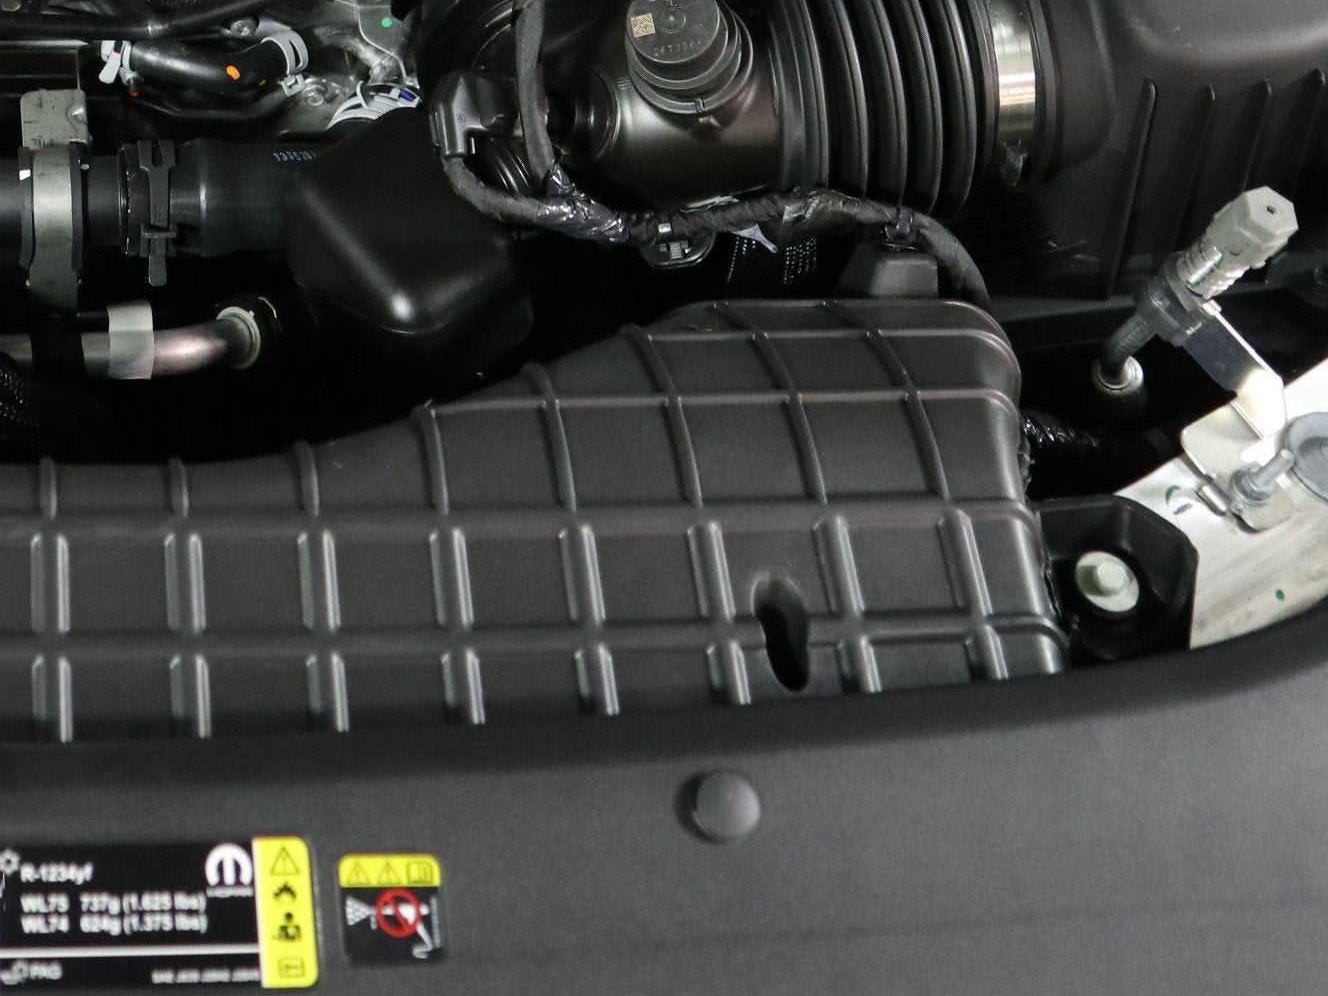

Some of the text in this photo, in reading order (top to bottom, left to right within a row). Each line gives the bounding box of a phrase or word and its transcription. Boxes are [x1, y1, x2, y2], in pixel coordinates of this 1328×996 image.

[20, 862, 94, 885] R-1234yf
[20, 892, 70, 913] WL75
[79, 891, 121, 915] 737g
[173, 891, 207, 913] lbs)
[20, 913, 70, 934] WL74
[174, 912, 208, 934] lbs)
